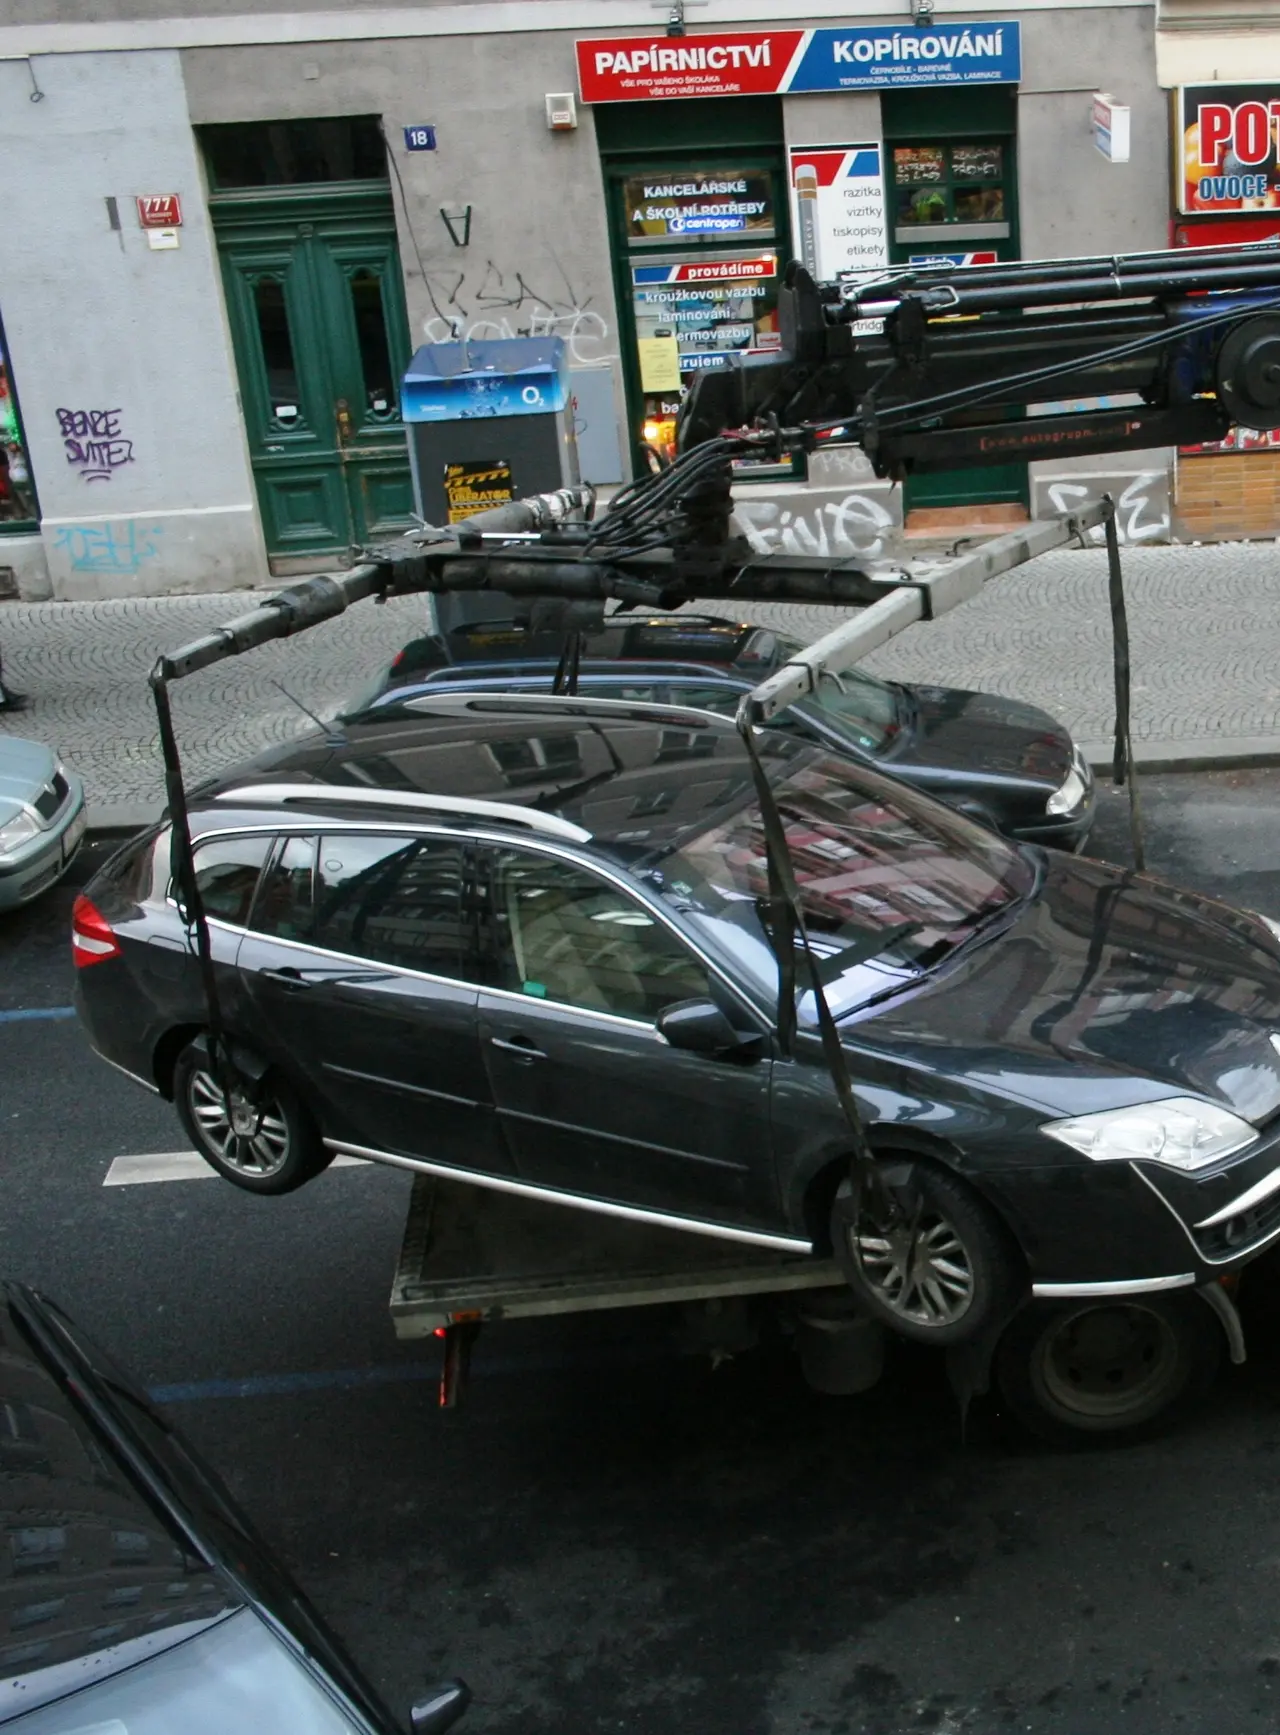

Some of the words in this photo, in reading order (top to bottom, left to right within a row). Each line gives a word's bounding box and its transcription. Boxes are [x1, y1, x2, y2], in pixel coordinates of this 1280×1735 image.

[833, 29, 1003, 63] KOPÍROVÁNÍ
[595, 39, 770, 75] PAPÍRNICTVÍ
[411, 130, 428, 146] 18
[644, 180, 747, 198] KANCELÁŘSKÉ
[1199, 174, 1268, 200] OVOCE
[143, 197, 171, 212] 777
[633, 211, 644, 222] A
[646, 203, 697, 221] ŠKOLNÍ
[700, 201, 765, 216] POTŘEBY
[846, 206, 882, 218] vizitky
[686, 217, 744, 230] centropen
[832, 227, 883, 239] tiskopisy
[846, 245, 884, 258] etikety
[688, 263, 763, 279] provádíme
[645, 289, 723, 303] kroužkovou
[725, 286, 766, 298] vazbu
[658, 306, 731, 322] laminování
[852, 319, 884, 332] rtridg
